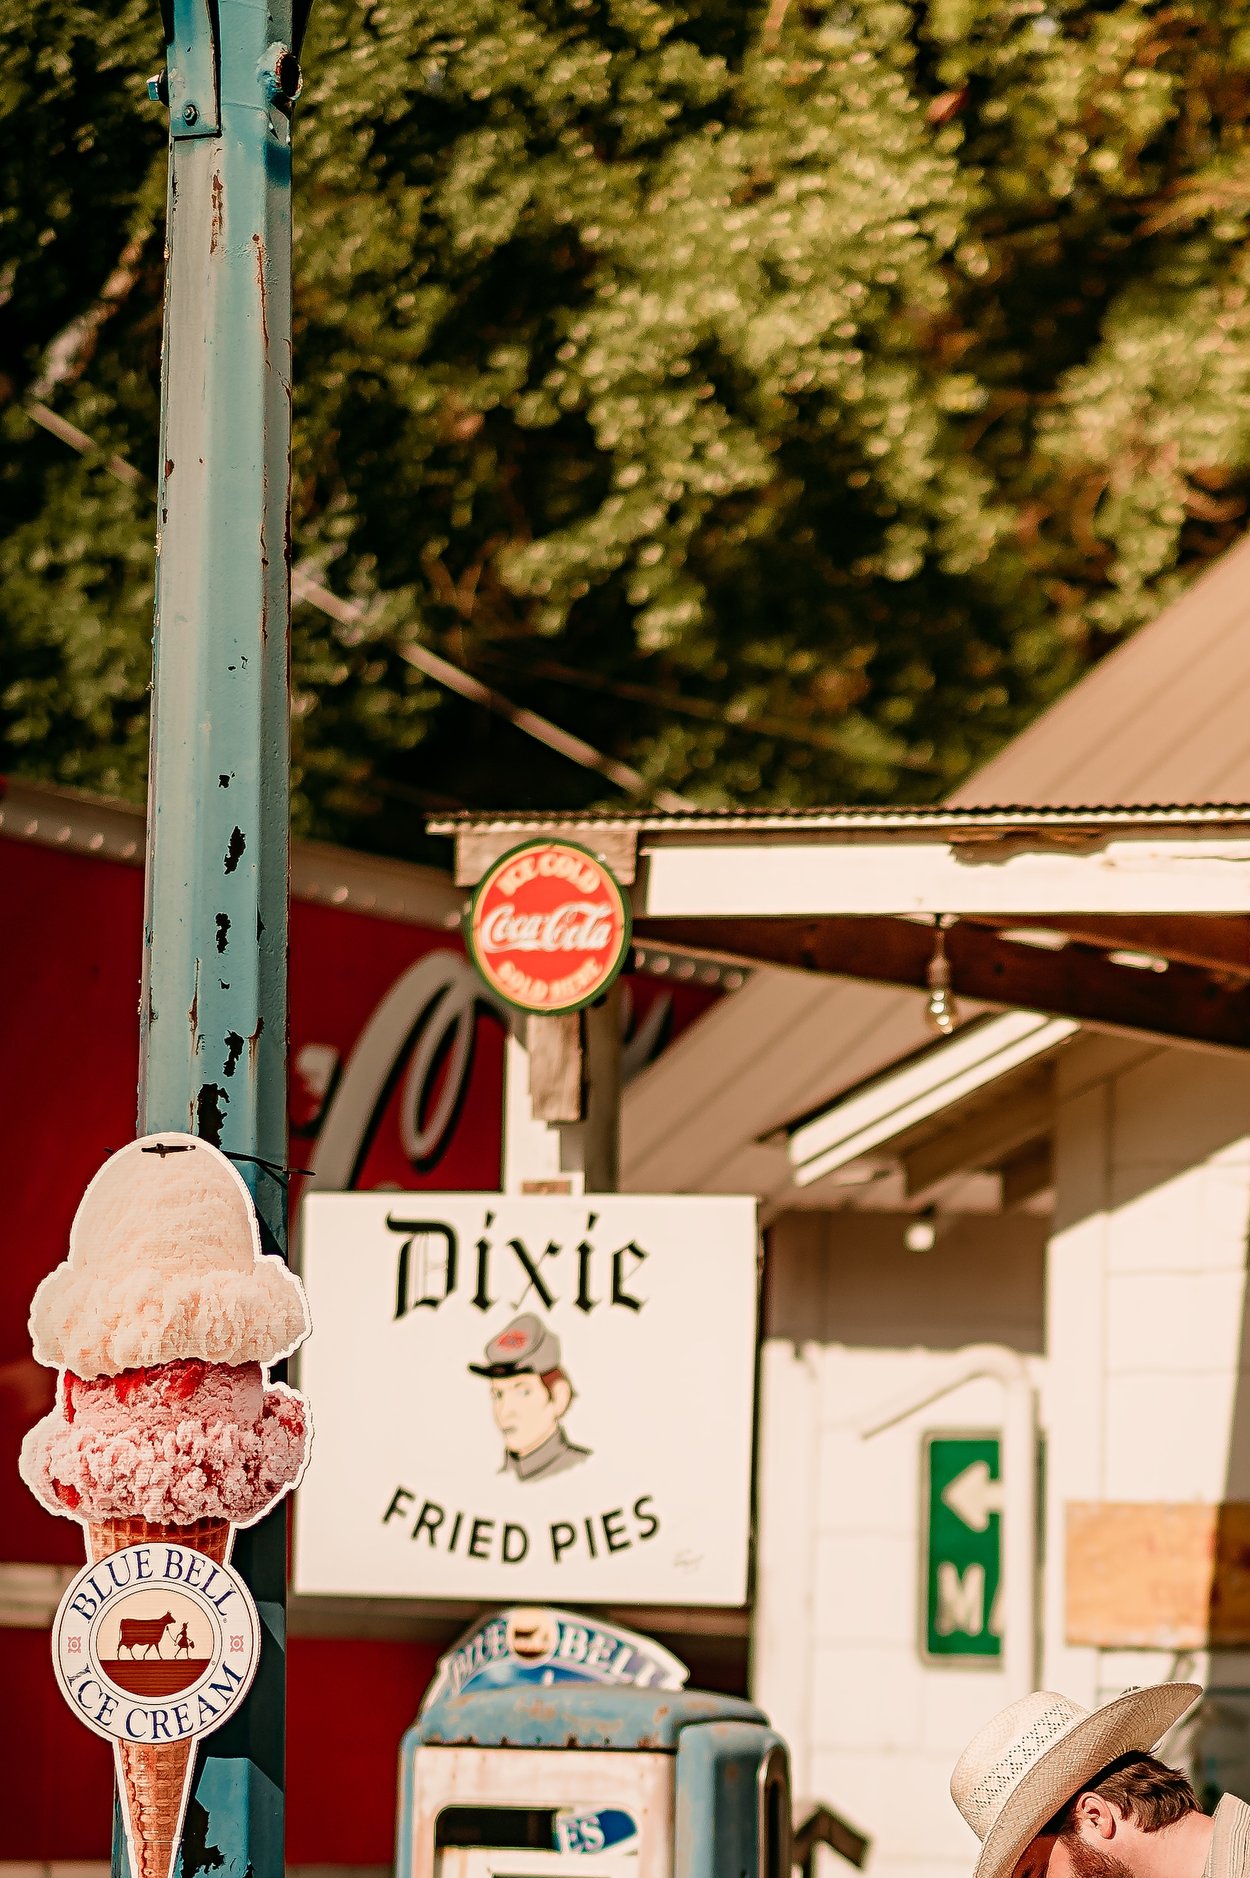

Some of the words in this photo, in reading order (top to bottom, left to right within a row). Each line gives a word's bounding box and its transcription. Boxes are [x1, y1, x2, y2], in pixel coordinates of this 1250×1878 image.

[538, 852, 601, 895] COLD
[481, 902, 614, 954] Coca-Cola
[384, 1209, 649, 1322] Dixie
[382, 1486, 530, 1566] FRIED
[550, 1494, 661, 1564] PIES
[70, 1548, 154, 1623] BLUE
[162, 1547, 236, 1617] BELL
[66, 1663, 119, 1727] ICE
[125, 1660, 244, 1740] CREAM
